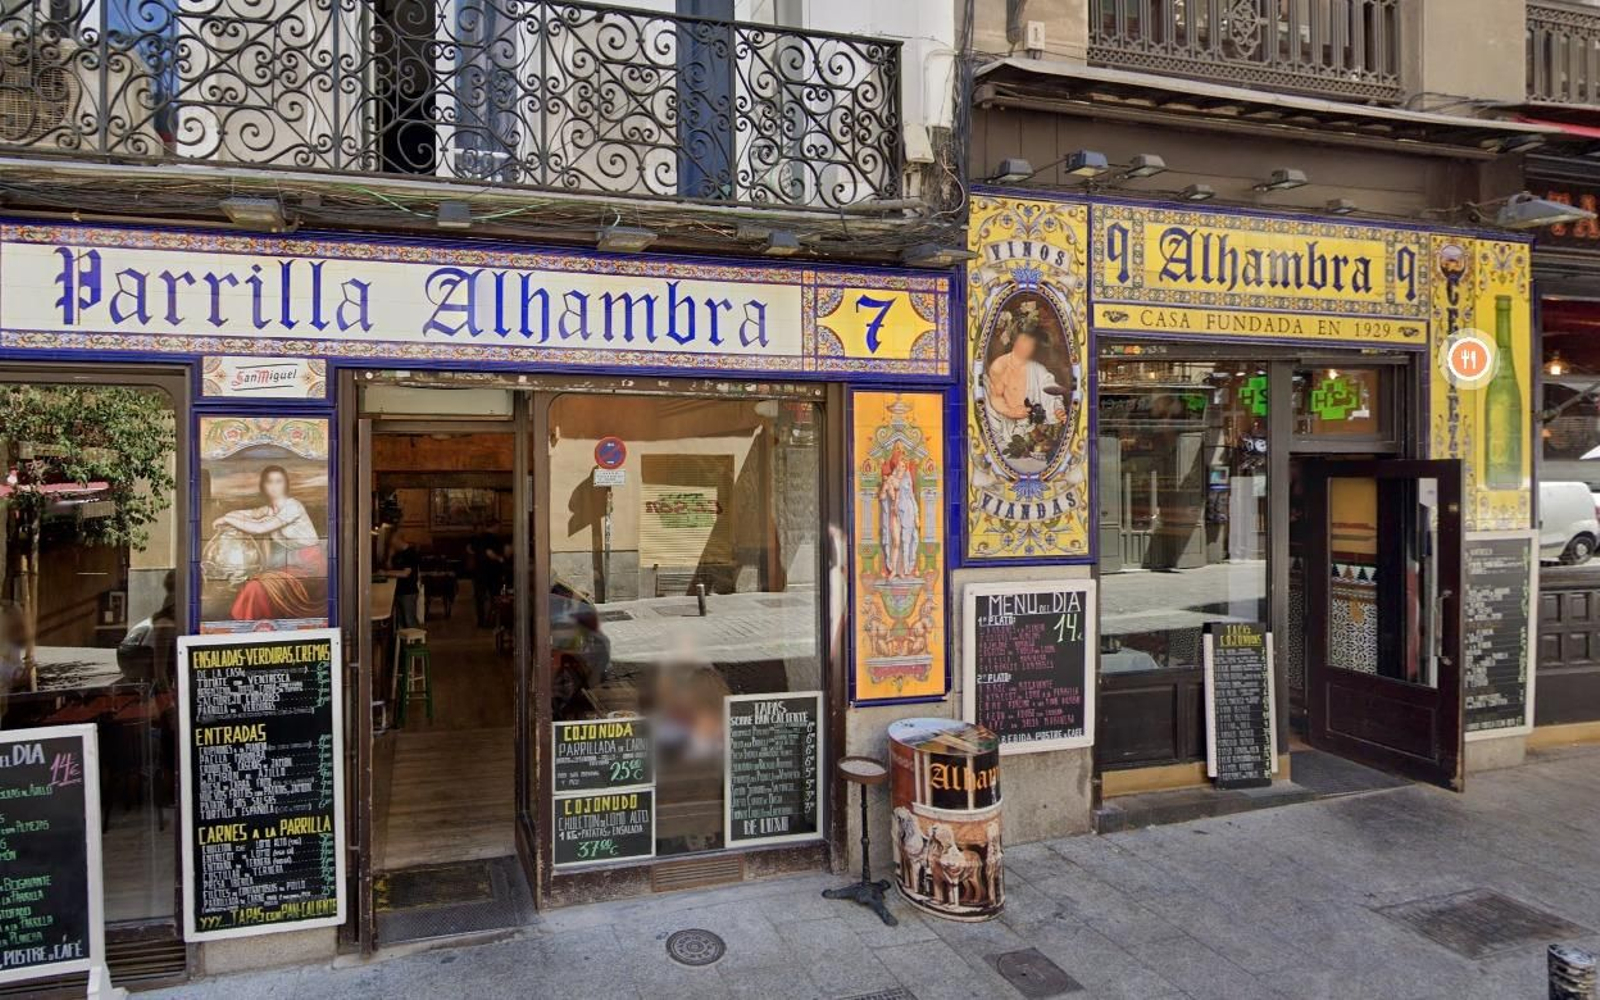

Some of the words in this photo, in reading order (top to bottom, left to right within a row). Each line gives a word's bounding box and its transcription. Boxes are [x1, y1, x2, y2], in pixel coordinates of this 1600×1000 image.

[990, 241, 1065, 267] VINOS
[1159, 227, 1373, 292] Alhambra
[54, 247, 371, 332] Parrilla
[423, 267, 768, 349] Alhambra
[855, 294, 897, 354] 7
[1139, 310, 1191, 330] CASA
[1206, 314, 1303, 335] FUNDADA
[1318, 320, 1341, 337] EN
[1354, 322, 1391, 338] 1929
[982, 492, 1077, 520] VIANDAS
[988, 594, 1037, 615] MENU
[1053, 591, 1081, 613] DIA
[195, 724, 267, 746] ENTRADAS
[13, 743, 46, 766] DIA
[558, 739, 616, 757] PARRILLADA
[564, 795, 637, 816] COJONUDO
[198, 823, 247, 846] CARNES
[253, 829, 260, 839] A
[265, 827, 276, 838] LA
[280, 815, 332, 836] PARRILLA
[744, 818, 757, 836] DE
